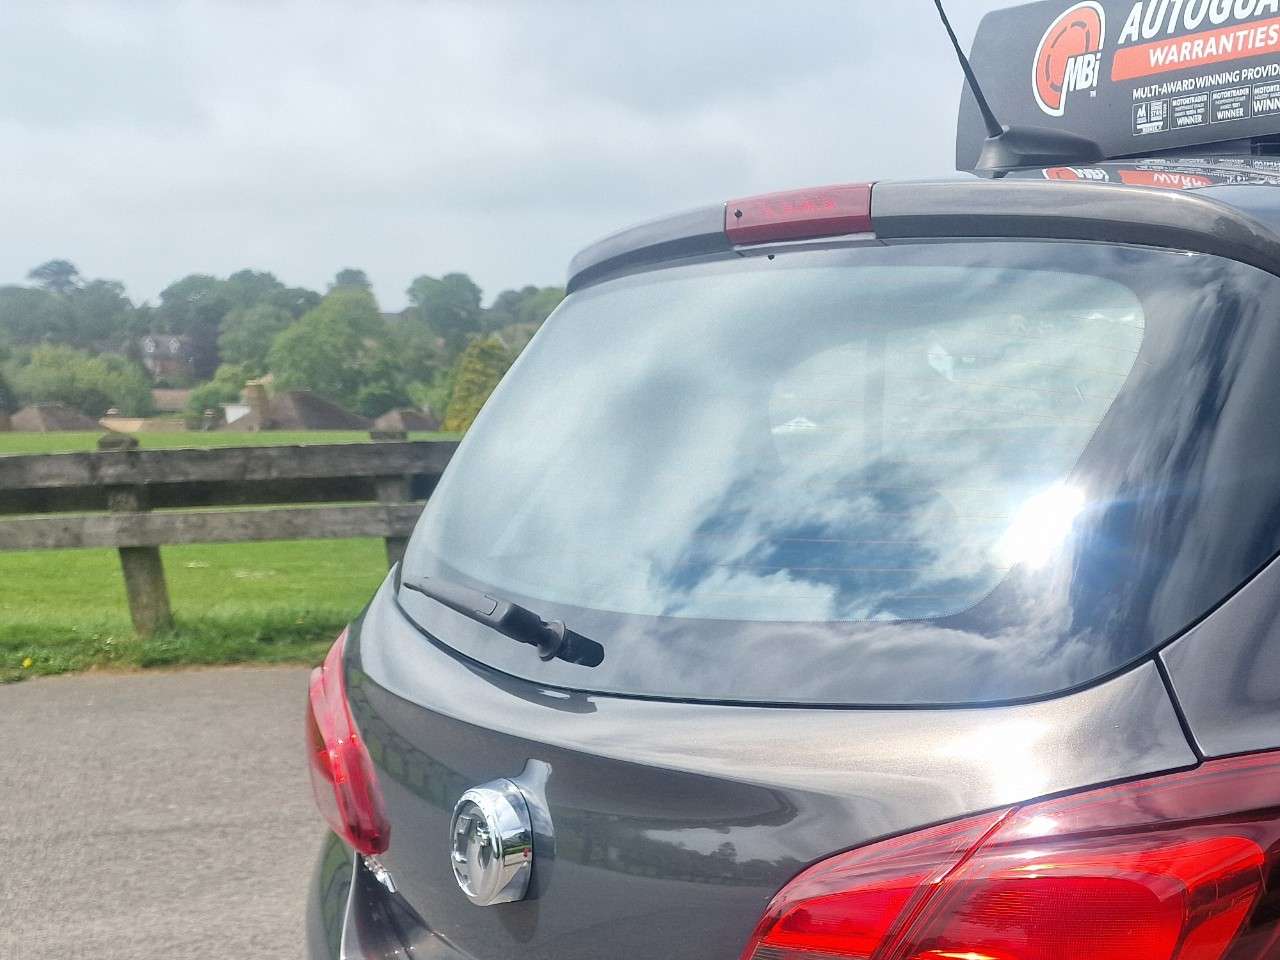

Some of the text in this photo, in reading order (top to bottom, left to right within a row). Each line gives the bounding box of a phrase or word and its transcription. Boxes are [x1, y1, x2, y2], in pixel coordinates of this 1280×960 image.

[1149, 24, 1280, 68] WARRANTIES
[1067, 52, 1102, 92] MBi
[1132, 77, 1195, 101] MULTI-AWARD
[1195, 70, 1240, 89] WINNING
[1216, 107, 1244, 120] WINNER
